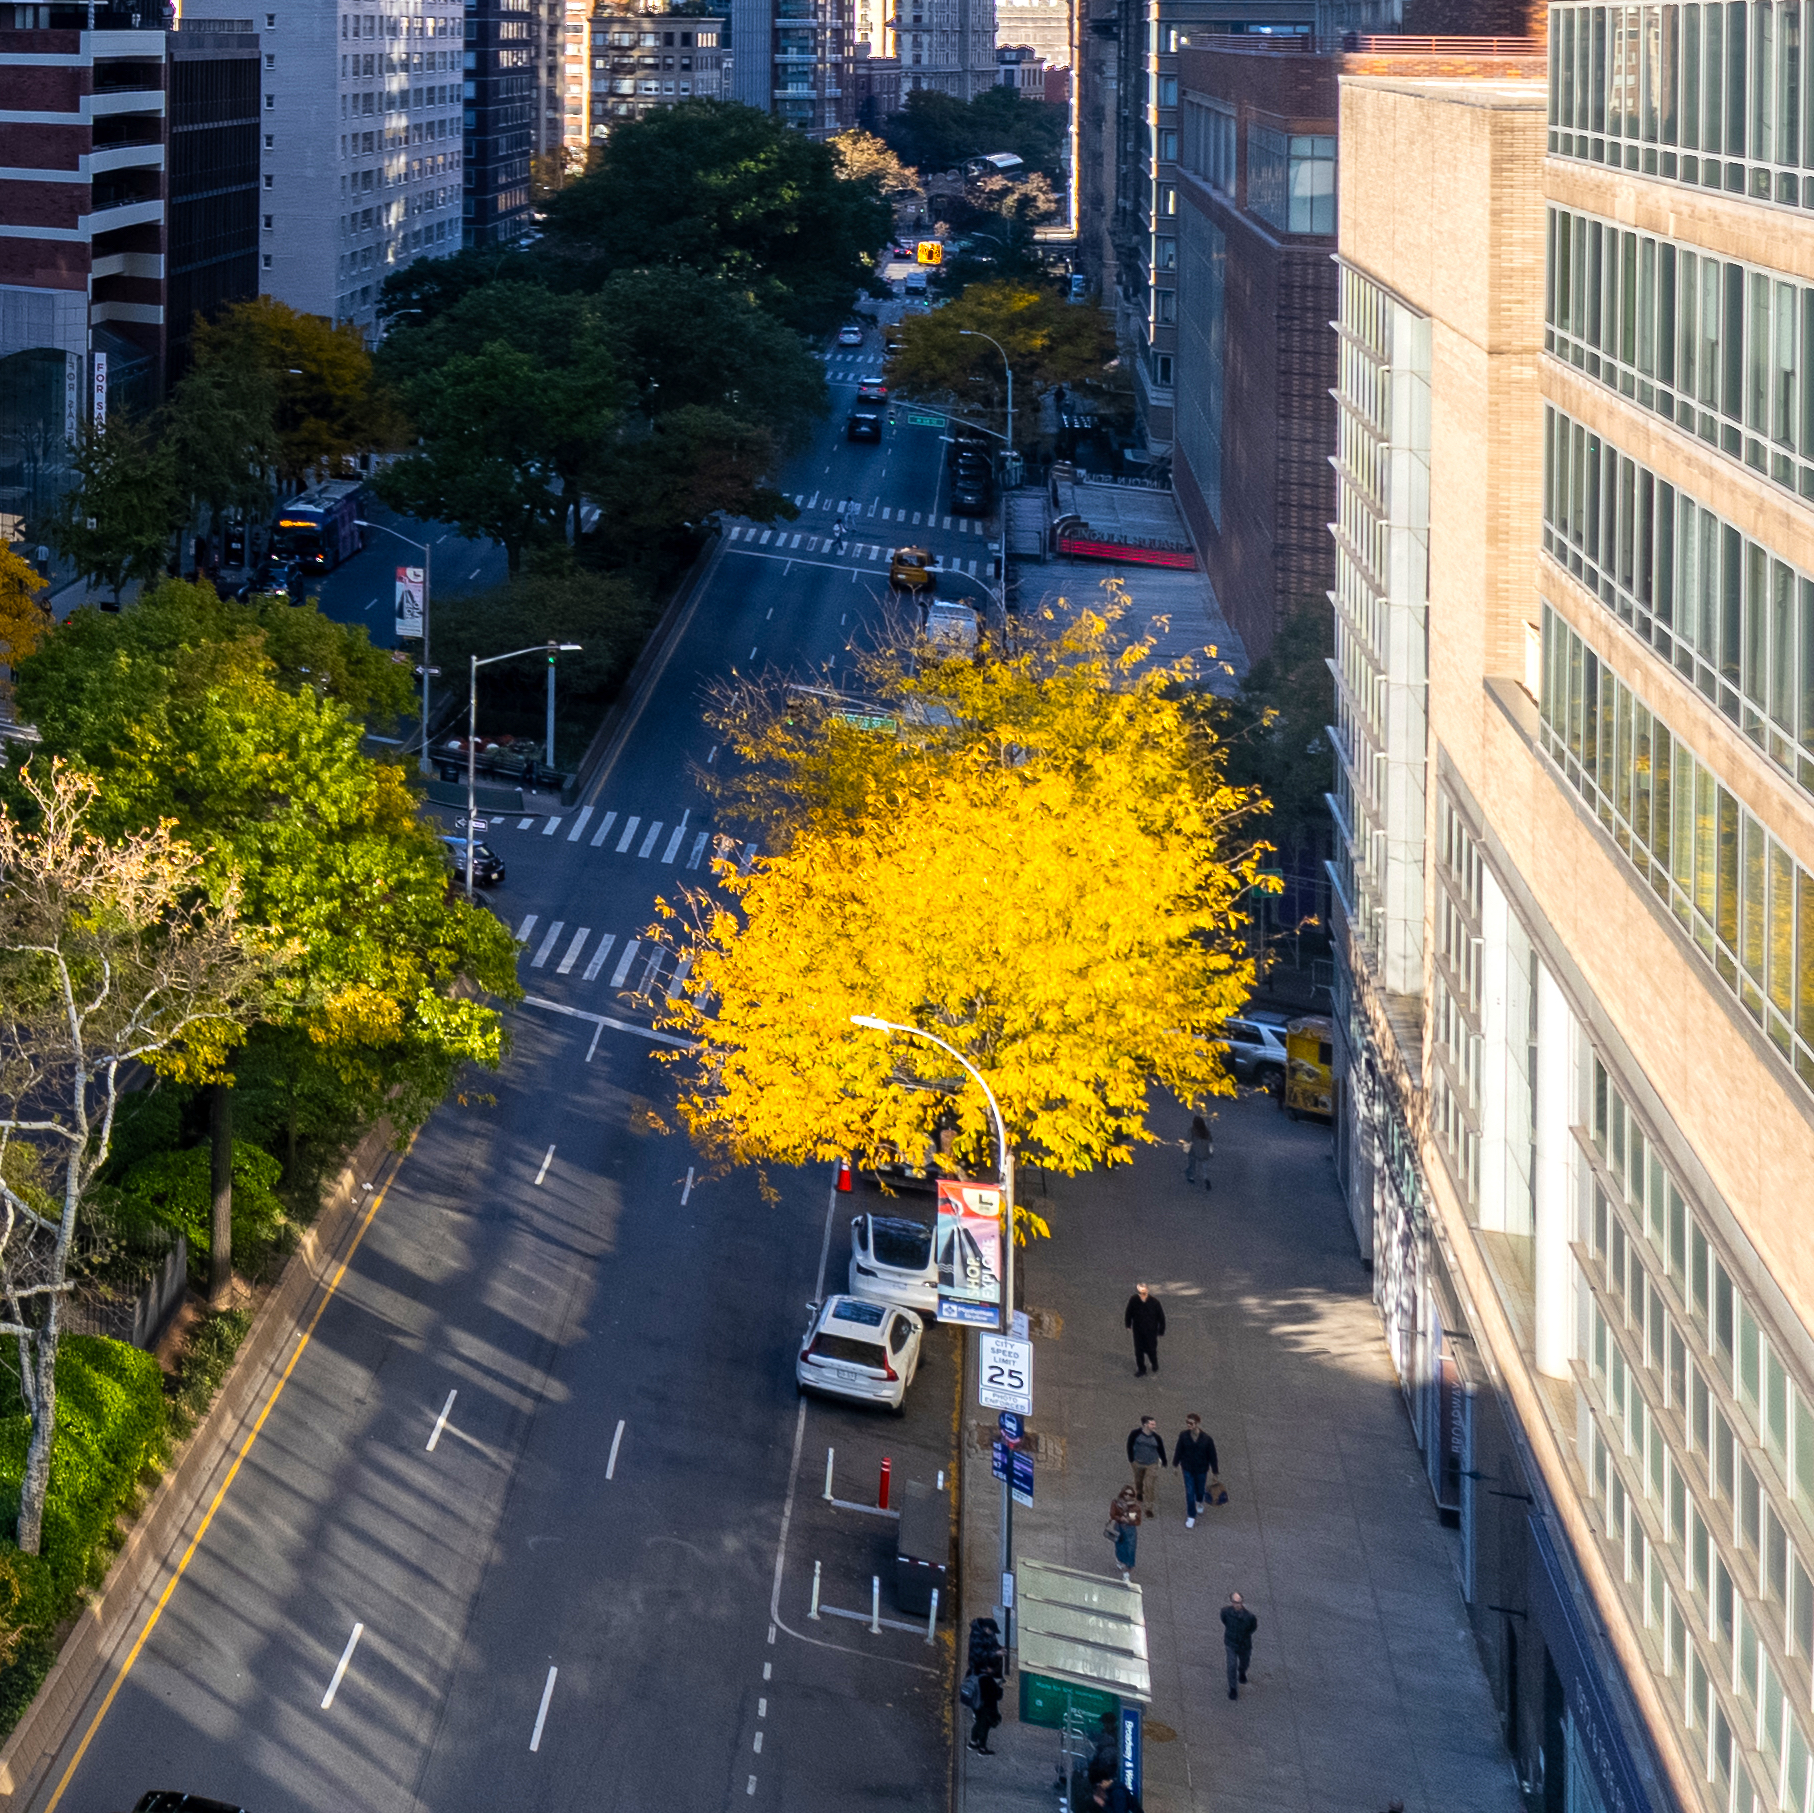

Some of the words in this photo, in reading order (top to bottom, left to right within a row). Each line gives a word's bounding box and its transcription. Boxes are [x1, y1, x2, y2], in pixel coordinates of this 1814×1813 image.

[96, 363, 105, 394] FOR
[994, 1339, 1016, 1350] CITY
[990, 1347, 1020, 1359] SPEED
[993, 1356, 1017, 1367] LIMIT
[987, 1365, 1024, 1389] 25
[984, 1396, 1026, 1411] ENFORCED
[992, 1393, 1019, 1403] PHOTO
[1123, 1720, 1134, 1761] Broadway
